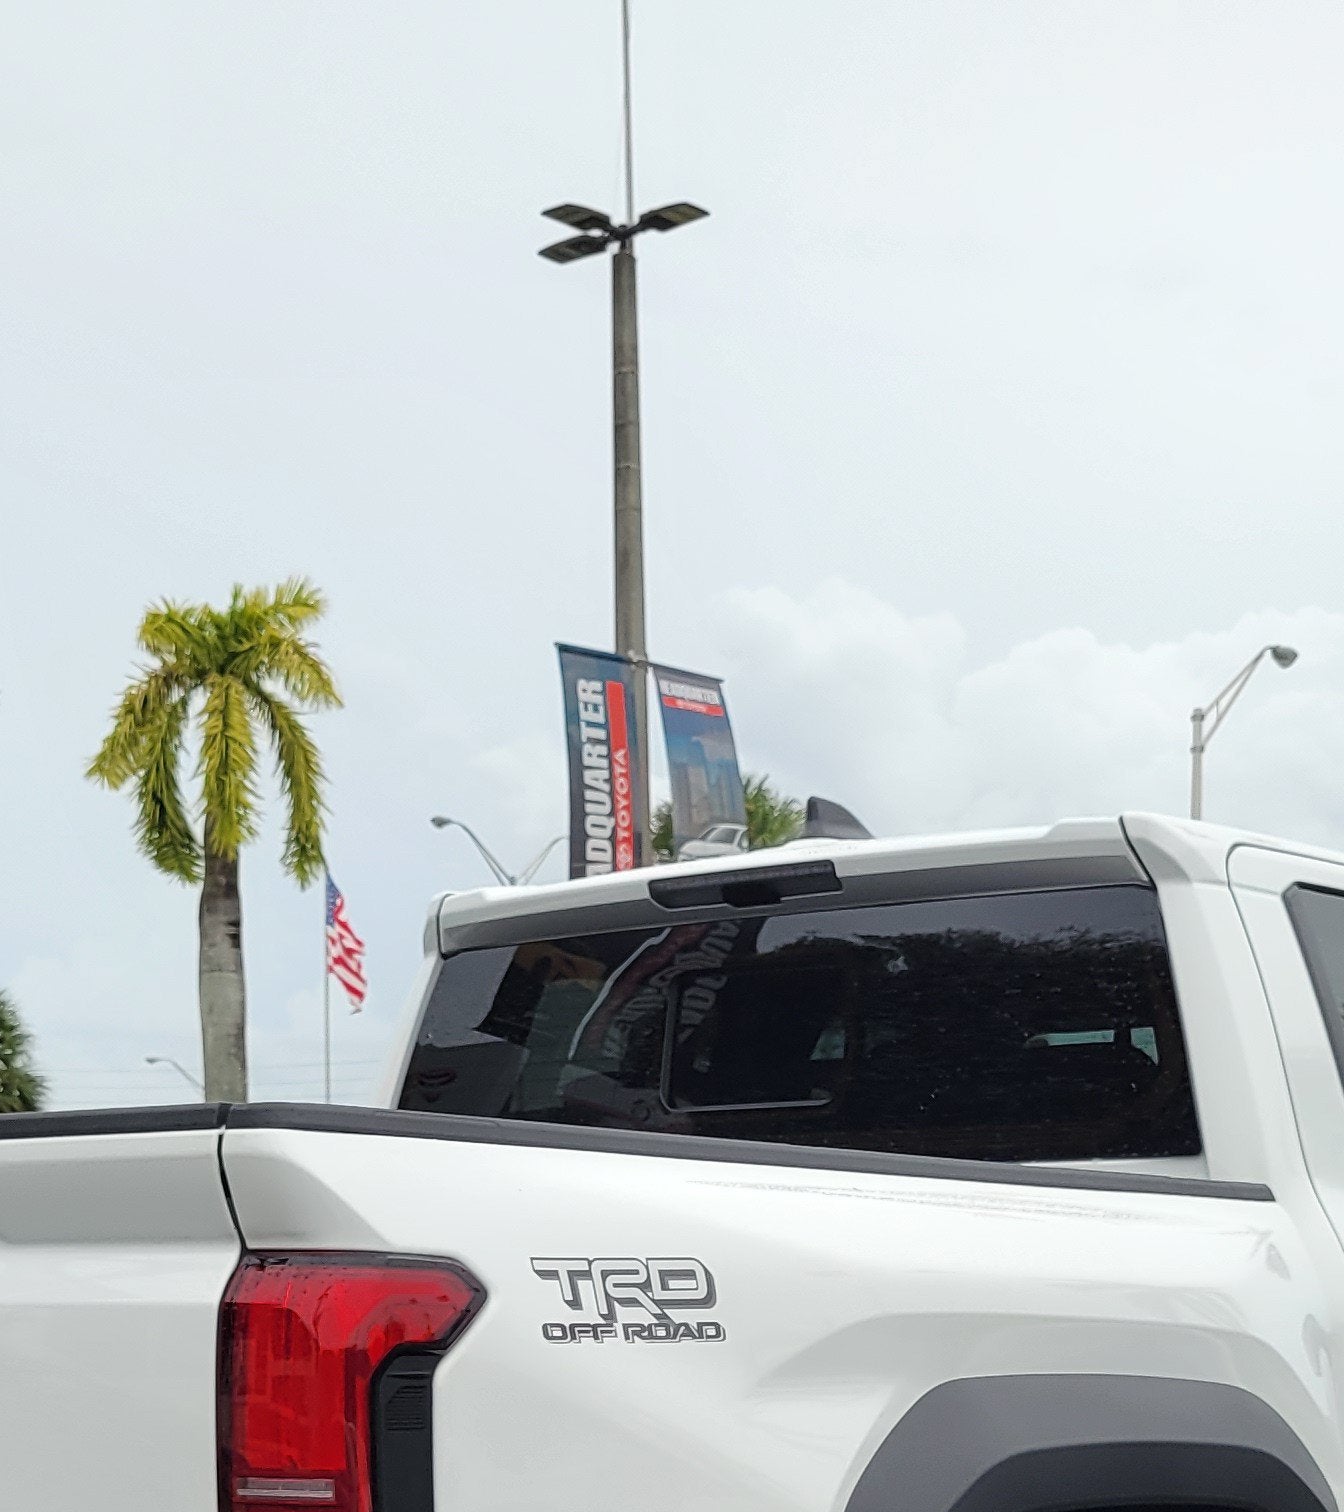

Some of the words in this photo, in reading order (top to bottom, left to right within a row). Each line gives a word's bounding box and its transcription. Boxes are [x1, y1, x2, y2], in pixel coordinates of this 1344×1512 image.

[613, 749, 631, 840] TOYOTA
[529, 1256, 717, 1324] TRD
[542, 1321, 619, 1344] OFF
[622, 1320, 727, 1344] ROAD
